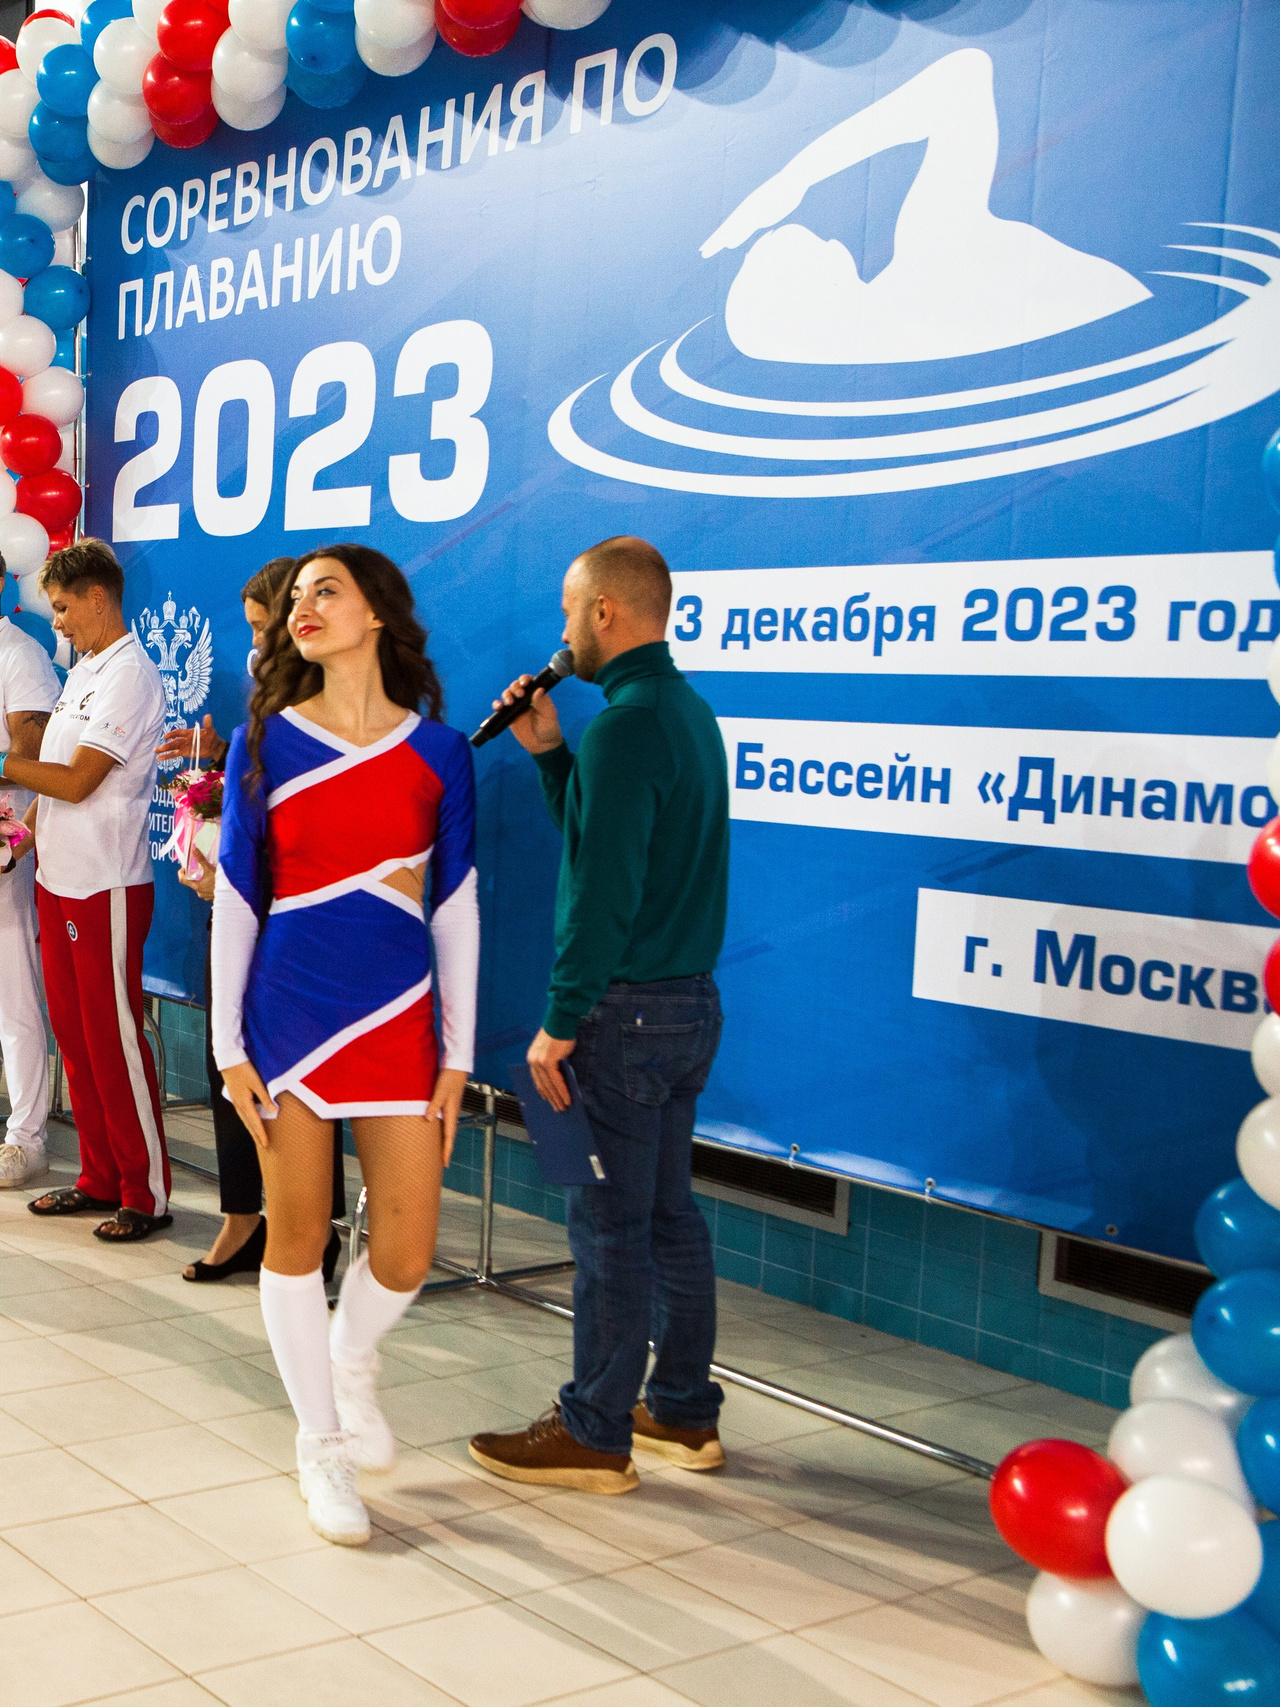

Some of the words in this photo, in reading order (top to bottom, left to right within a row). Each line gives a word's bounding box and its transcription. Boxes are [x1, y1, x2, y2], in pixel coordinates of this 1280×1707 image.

[120, 69, 546, 255] СОРЕВНОВАНИЯ
[569, 32, 678, 134] ПО
[117, 214, 403, 340] ПЛАВАНИЮ
[112, 318, 494, 543] 2023
[720, 591, 937, 657] декабря
[961, 584, 1137, 642] 2023
[735, 741, 952, 804] Бассейн
[977, 755, 1279, 828] «Динамо
[963, 935, 1003, 977] г.
[1033, 928, 1271, 1015] Москв
